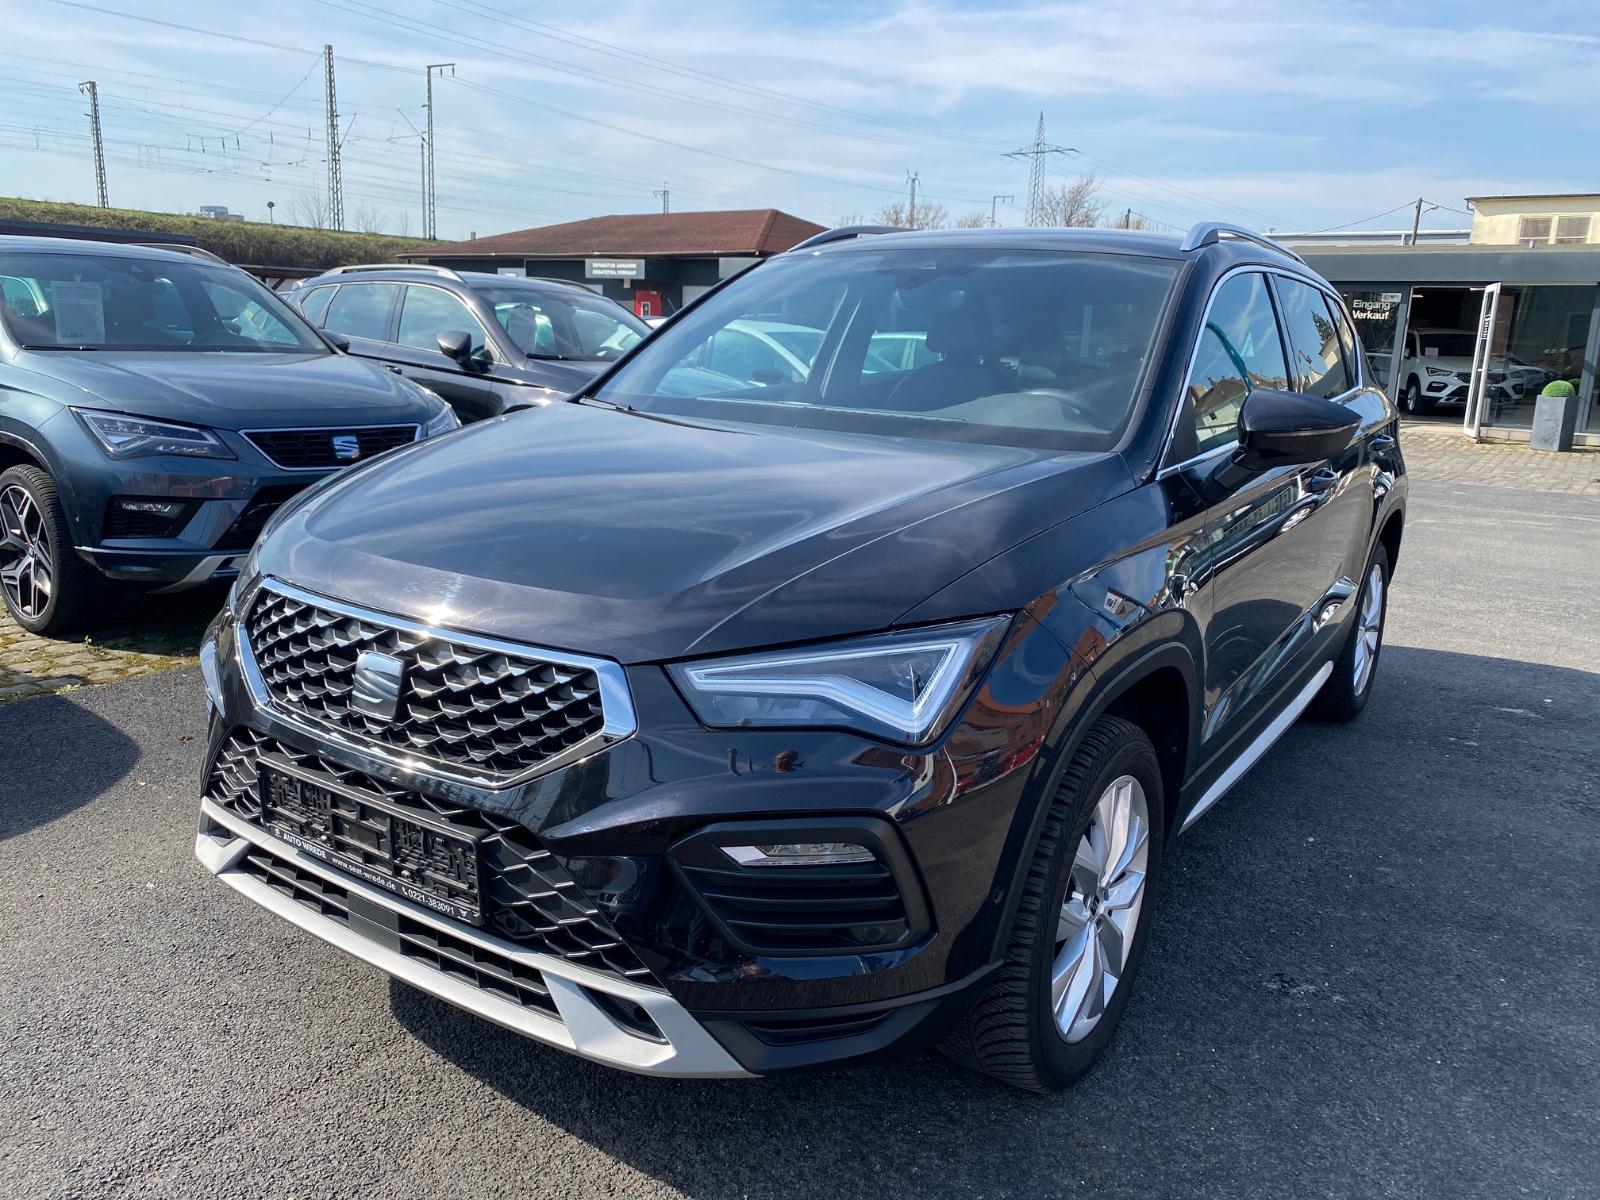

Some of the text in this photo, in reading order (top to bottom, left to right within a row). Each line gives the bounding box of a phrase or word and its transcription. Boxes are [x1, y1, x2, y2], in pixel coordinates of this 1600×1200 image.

[1353, 299, 1390, 311] Eingang
[1352, 310, 1389, 320] Verkauf
[283, 832, 454, 915] AUTO WREDE www.seat-wrede.de 0221-383091
